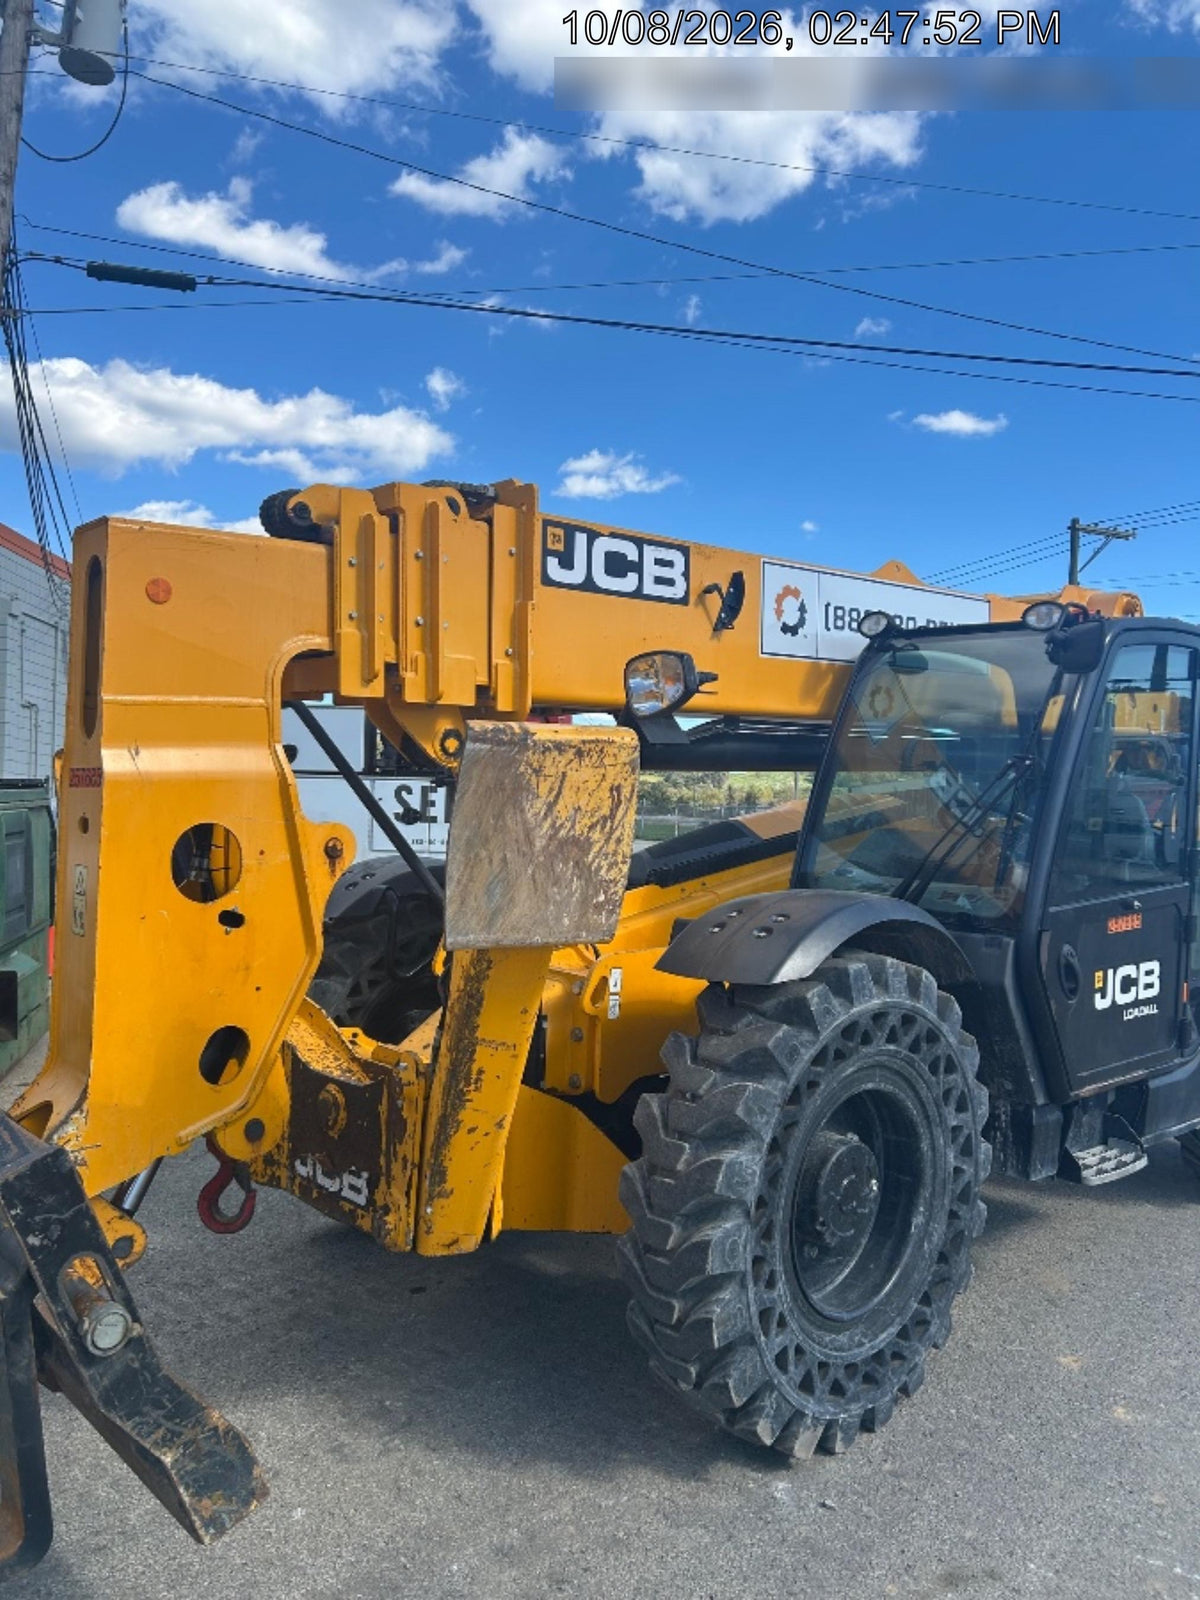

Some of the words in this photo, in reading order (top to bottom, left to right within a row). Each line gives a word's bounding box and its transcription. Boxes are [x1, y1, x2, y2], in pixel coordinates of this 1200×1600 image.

[547, 531, 687, 599] JCB
[1094, 960, 1161, 1010] JCB
[1123, 1004, 1159, 1021] LOADALL
